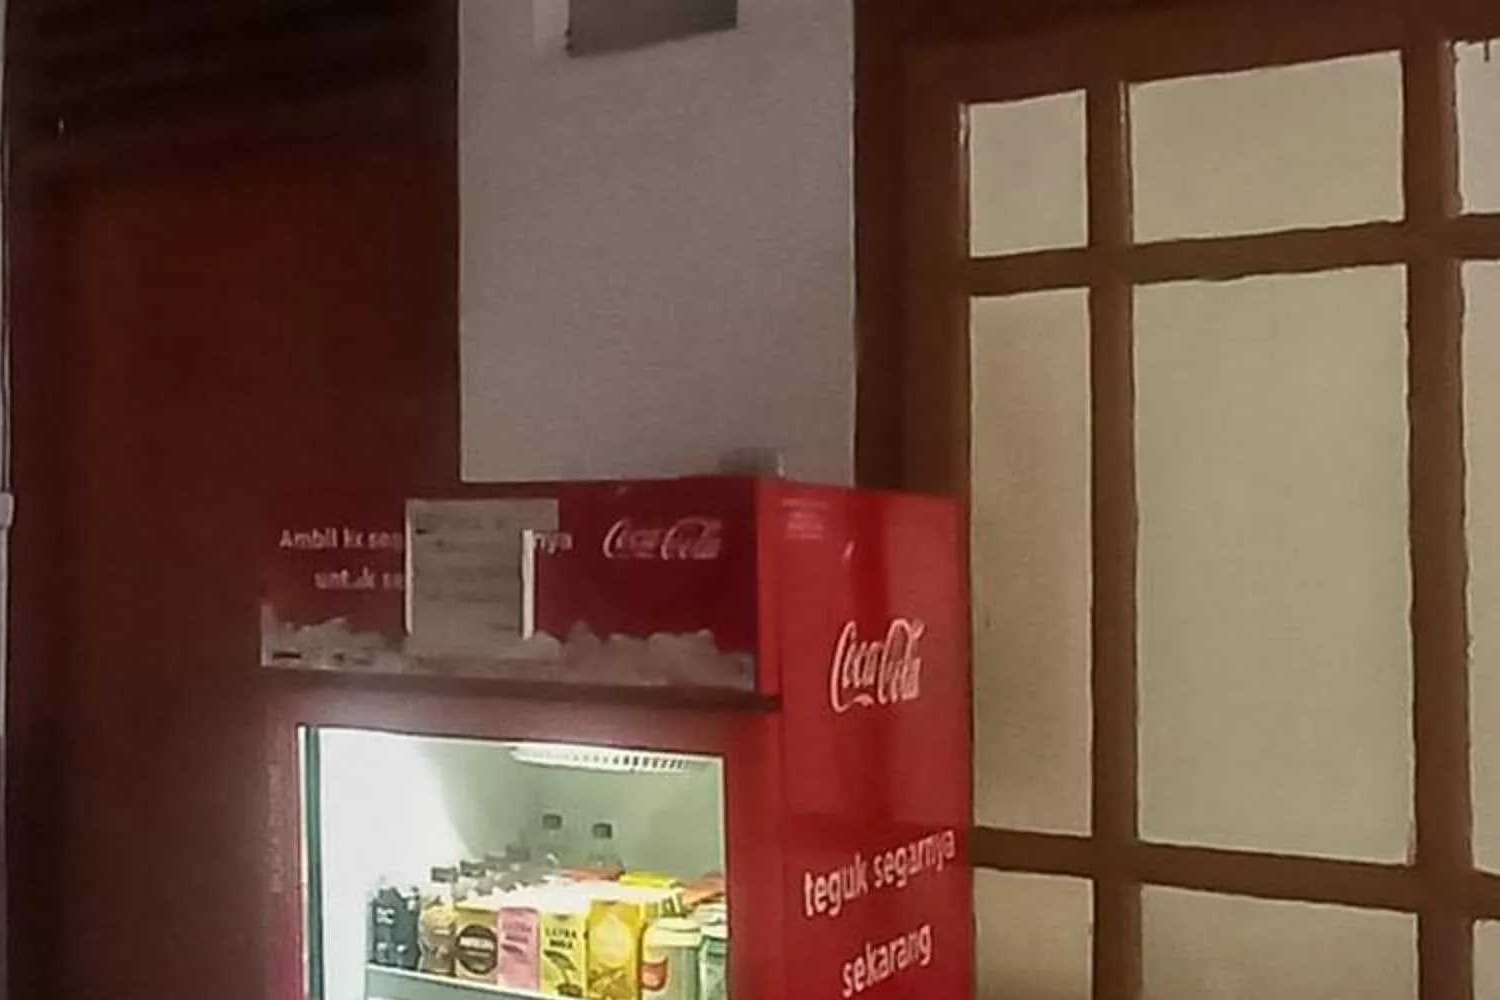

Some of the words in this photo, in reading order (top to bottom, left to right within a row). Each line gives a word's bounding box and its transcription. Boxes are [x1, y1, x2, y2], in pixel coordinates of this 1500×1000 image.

[279, 527, 337, 549] Ambil
[534, 532, 573, 553] nya
[831, 618, 925, 713] Coca-Cola
[804, 852, 869, 918] teguk
[873, 829, 956, 888] segarnya
[842, 924, 933, 998] sekarang
